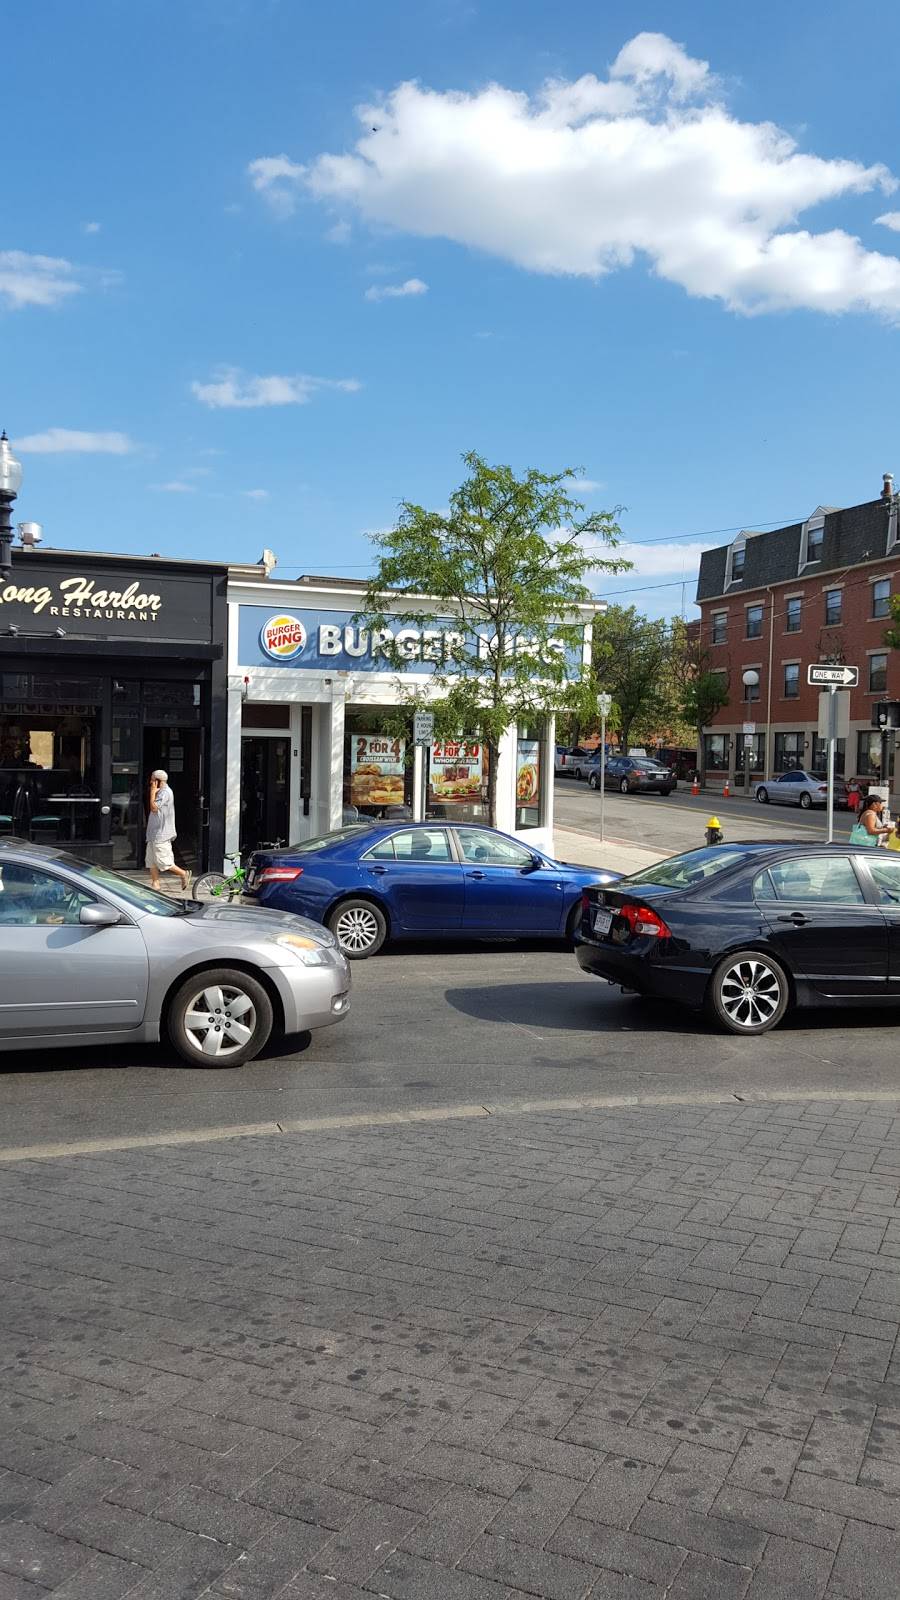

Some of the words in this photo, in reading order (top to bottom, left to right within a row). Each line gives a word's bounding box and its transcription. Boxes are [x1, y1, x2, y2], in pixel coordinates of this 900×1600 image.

[0, 577, 53, 614] ong
[60, 577, 162, 611] Harbor
[50, 606, 158, 621] RESTAURANT
[267, 623, 301, 639] BURGER
[268, 632, 302, 650] KING
[319, 624, 467, 661] BURGER
[814, 671, 828, 679] ONE
[357, 738, 368, 756] 2
[369, 743, 389, 753] FOR
[433, 741, 442, 756] 2
[444, 747, 460, 757] FOR
